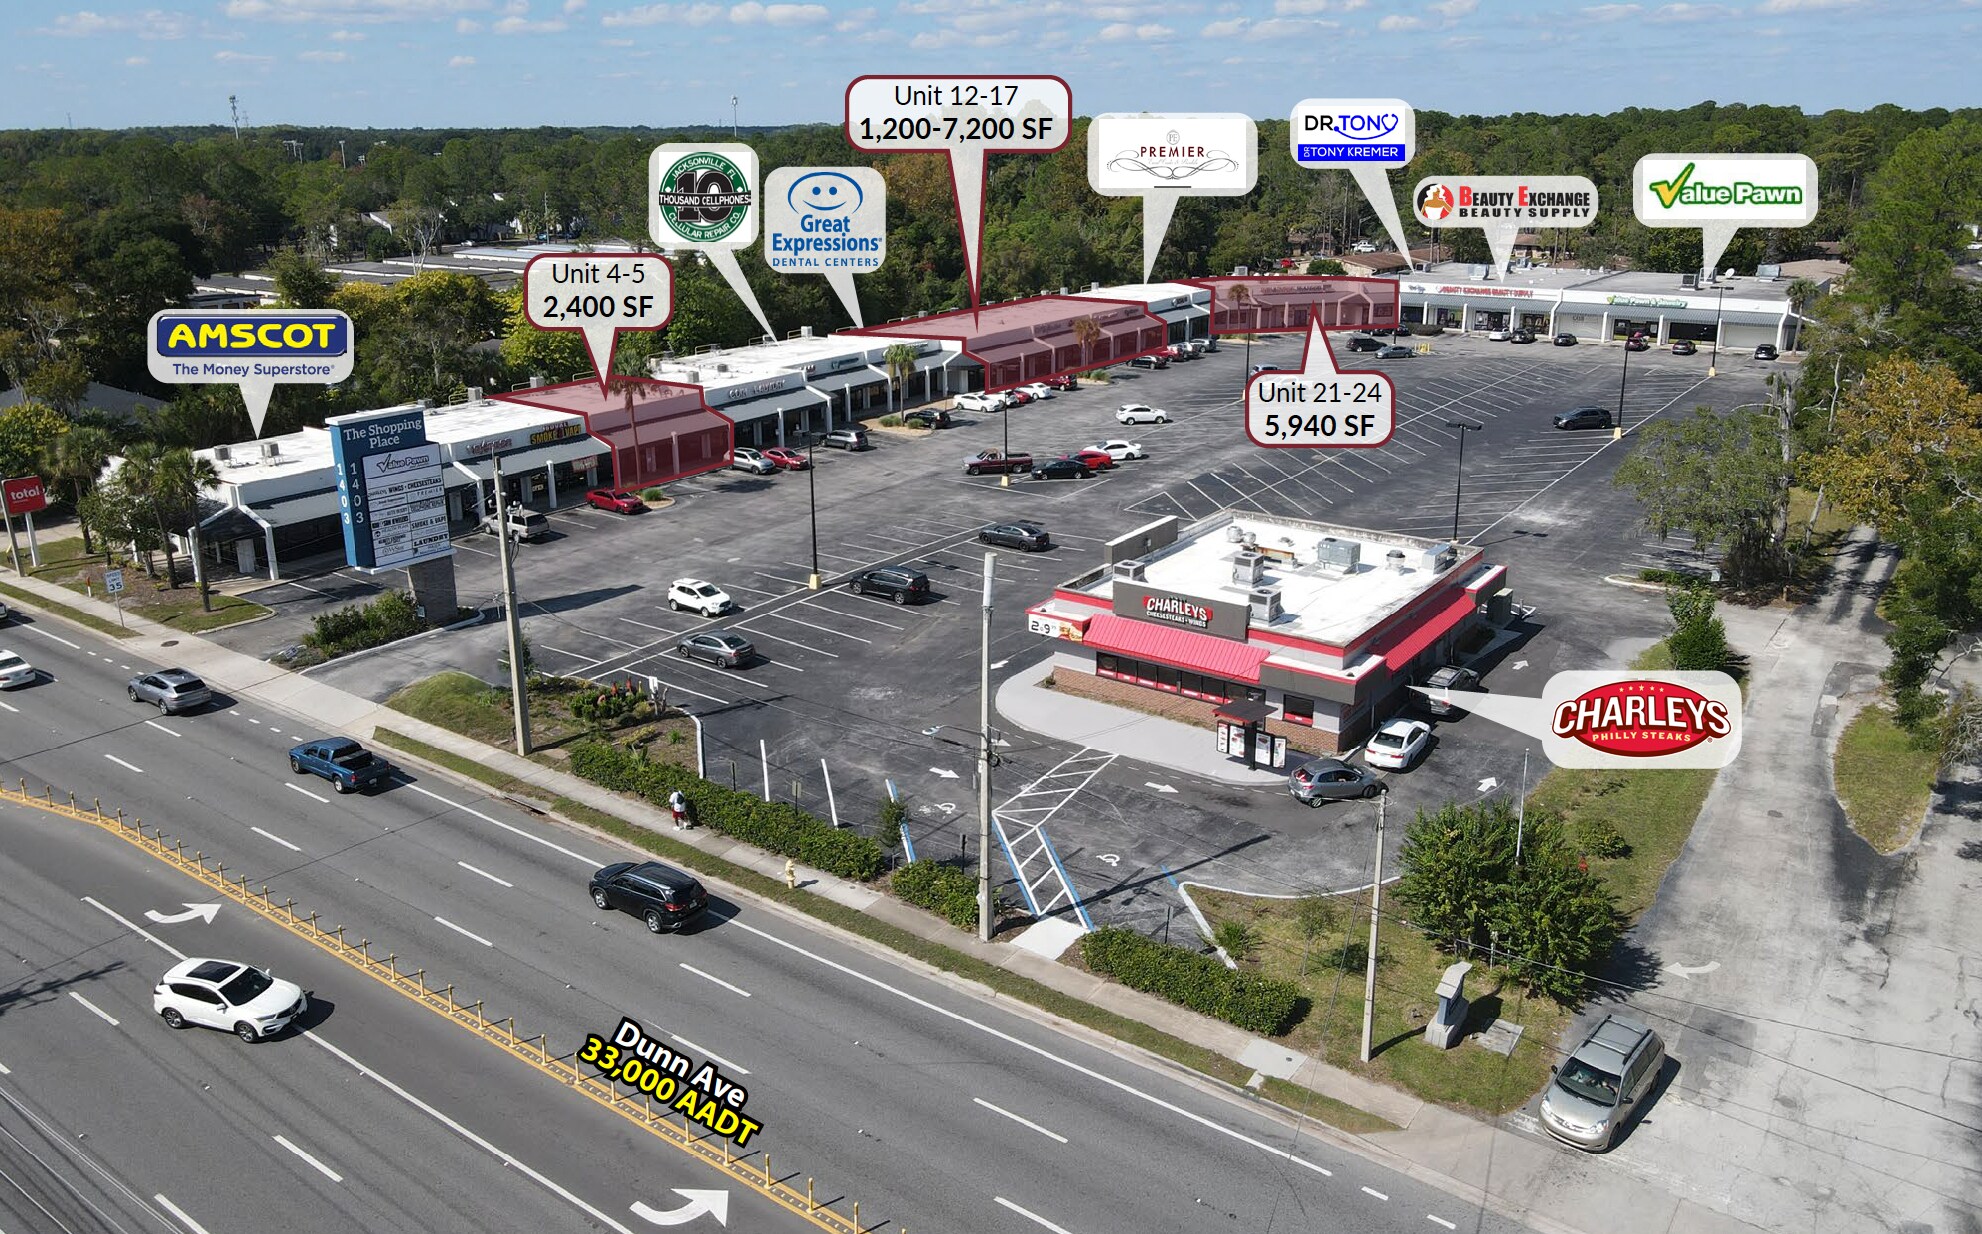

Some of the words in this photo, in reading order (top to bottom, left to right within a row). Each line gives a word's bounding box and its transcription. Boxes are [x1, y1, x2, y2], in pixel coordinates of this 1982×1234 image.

[343, 428, 367, 441] The
[368, 419, 422, 436] Shopping
[531, 430, 558, 444] SMOKE
[369, 435, 400, 449] Place
[11, 485, 40, 500] total
[413, 533, 449, 547] LAUNDRY
[109, 581, 123, 591] 35
[1146, 598, 1208, 621] CHARLEYS
[1031, 620, 1040, 631] 2
[1188, 618, 1206, 628] WINGS
